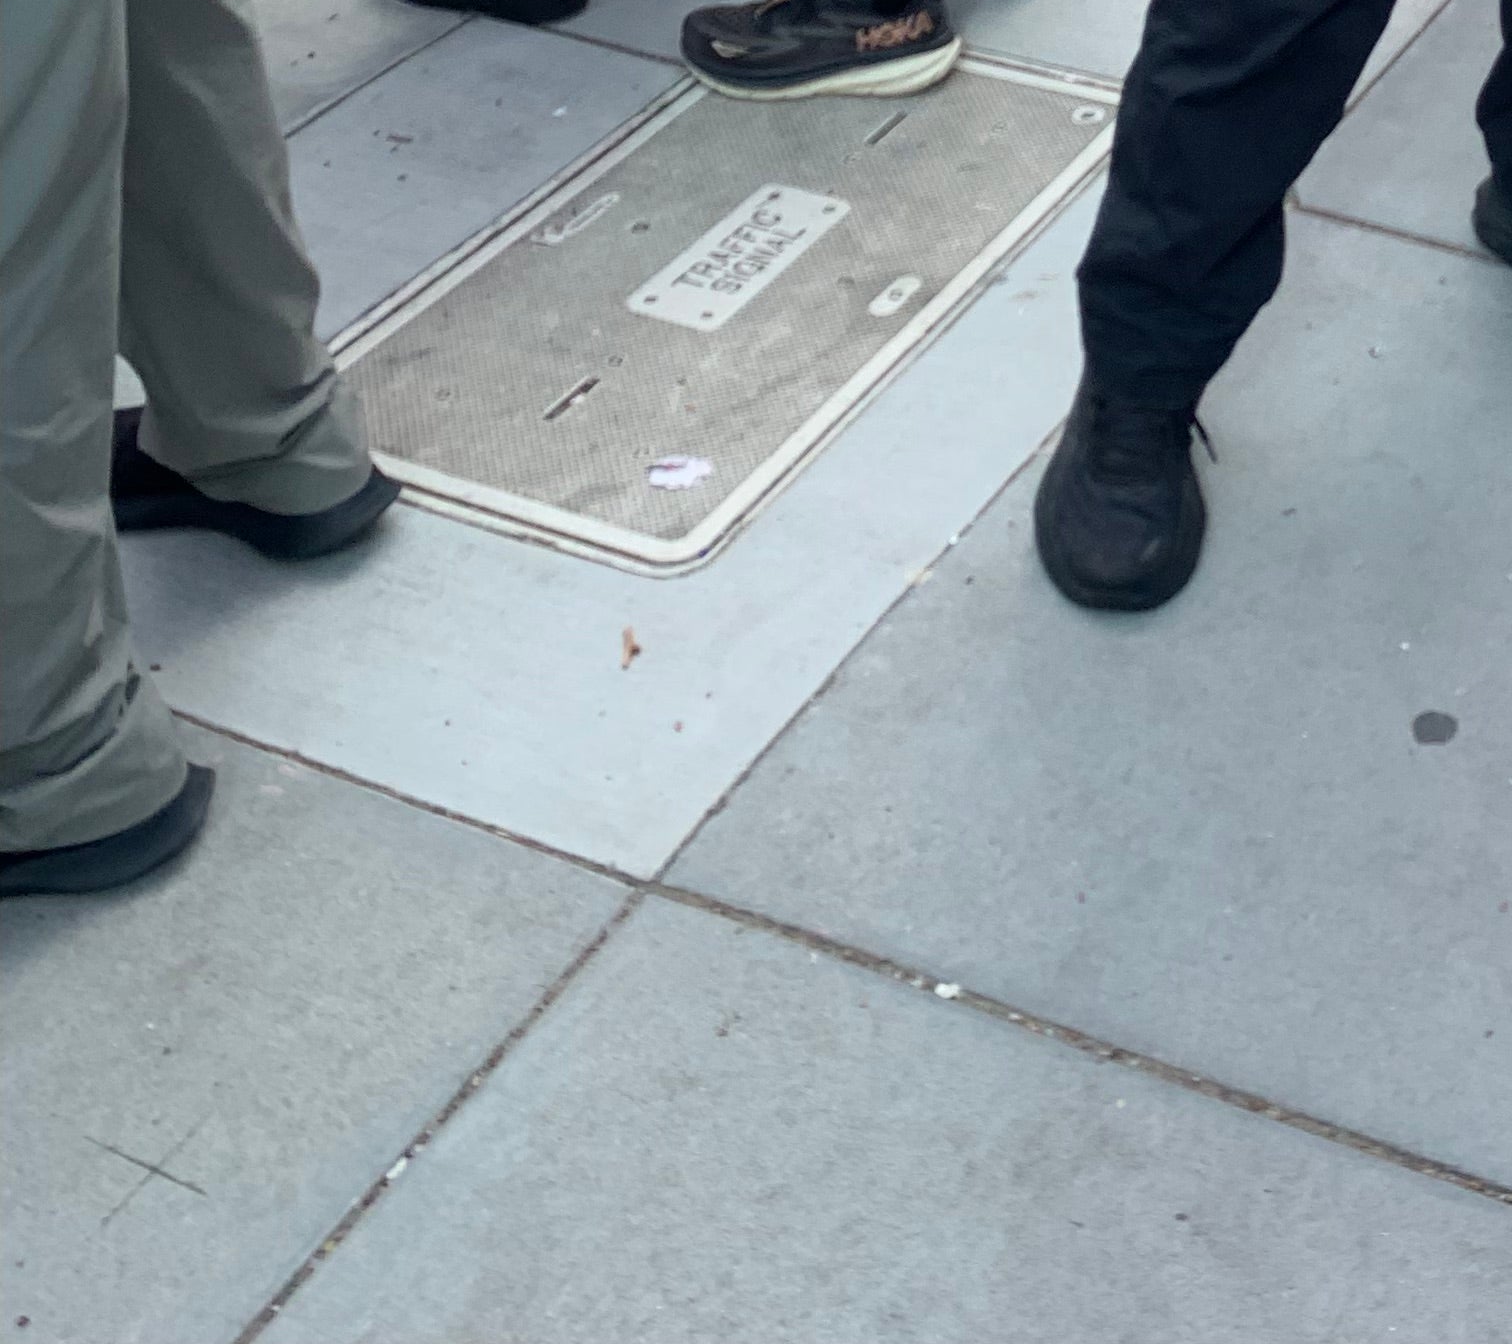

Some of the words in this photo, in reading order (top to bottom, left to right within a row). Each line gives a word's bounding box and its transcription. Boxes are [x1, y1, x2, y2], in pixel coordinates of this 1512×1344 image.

[855, 10, 934, 52] HOKA
[671, 208, 782, 288] TRAFFIC
[710, 227, 807, 296] SIGNAL
